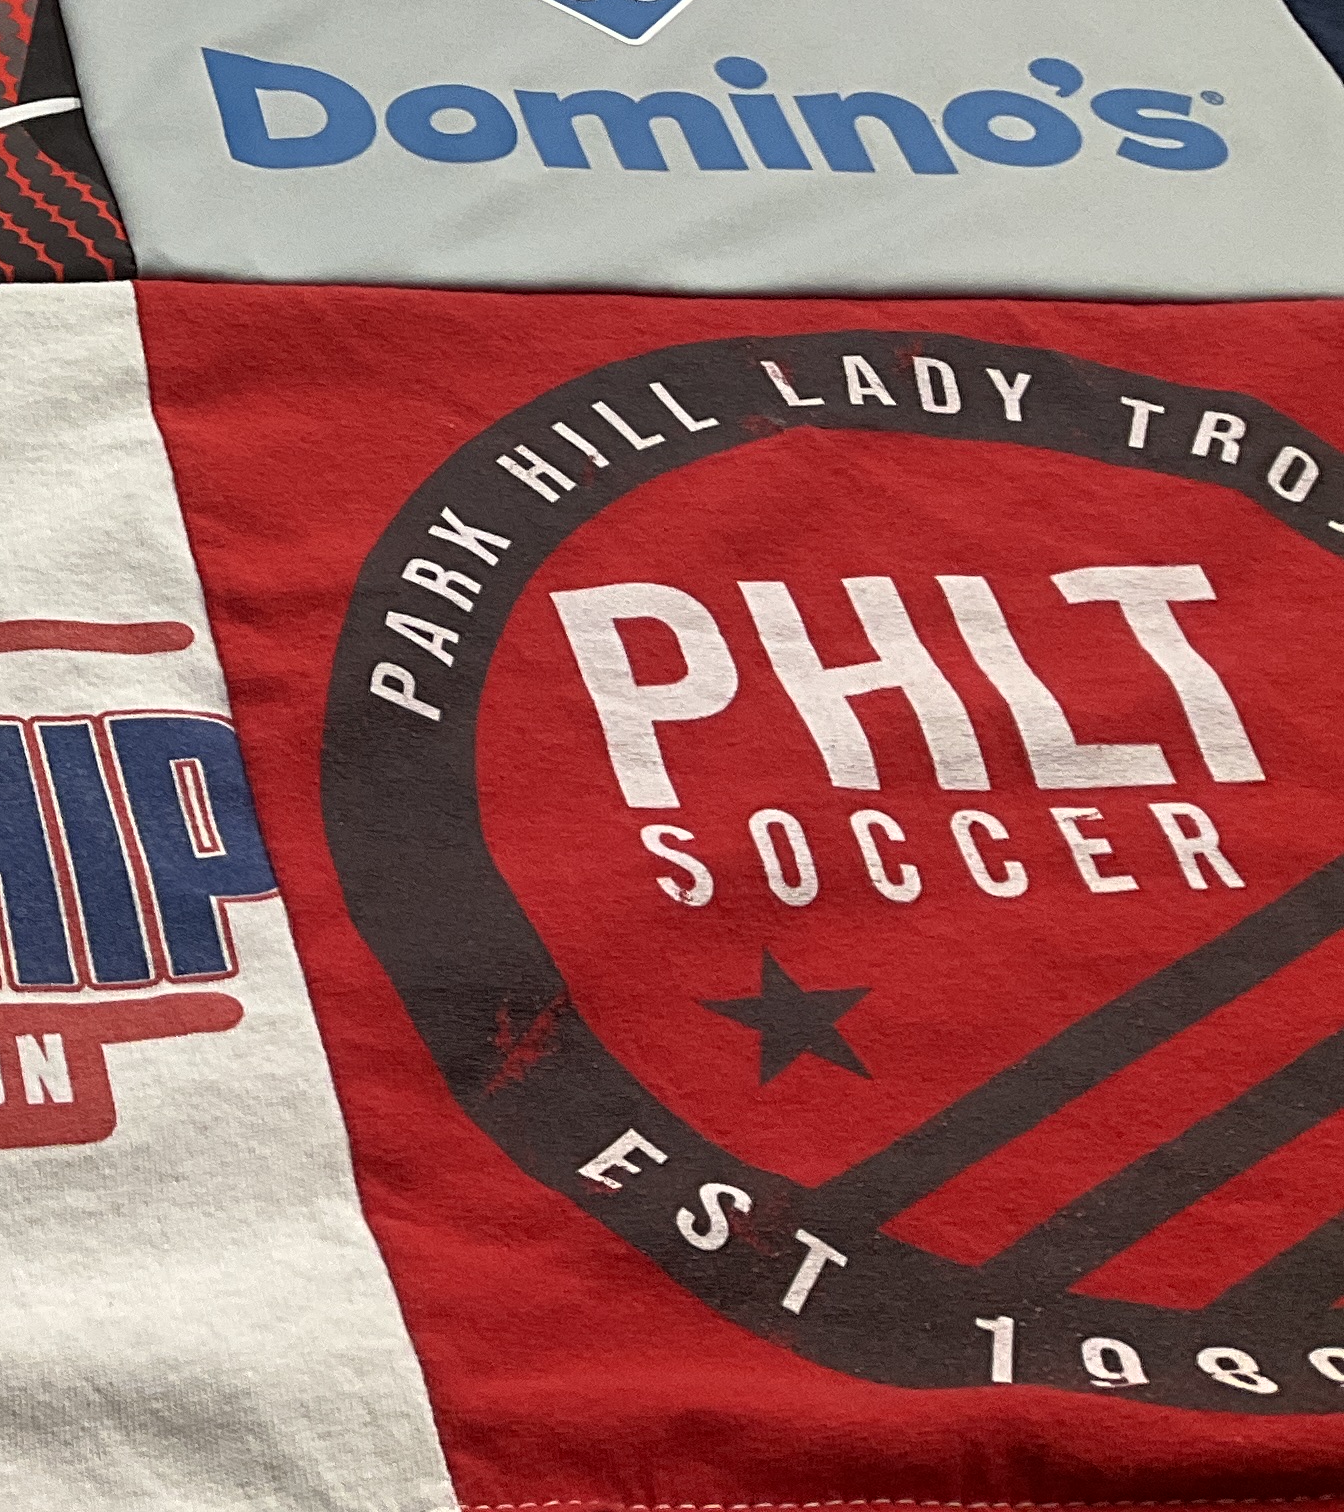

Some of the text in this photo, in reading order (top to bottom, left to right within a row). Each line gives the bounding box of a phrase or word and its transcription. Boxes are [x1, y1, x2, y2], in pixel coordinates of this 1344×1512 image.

[201, 47, 1230, 176] Domino's
[369, 353, 1344, 722] PARK HILL LADY TRO
[548, 564, 1267, 810] PHLT
[641, 802, 1247, 908] SOCCER
[578, 1127, 849, 1317] EST
